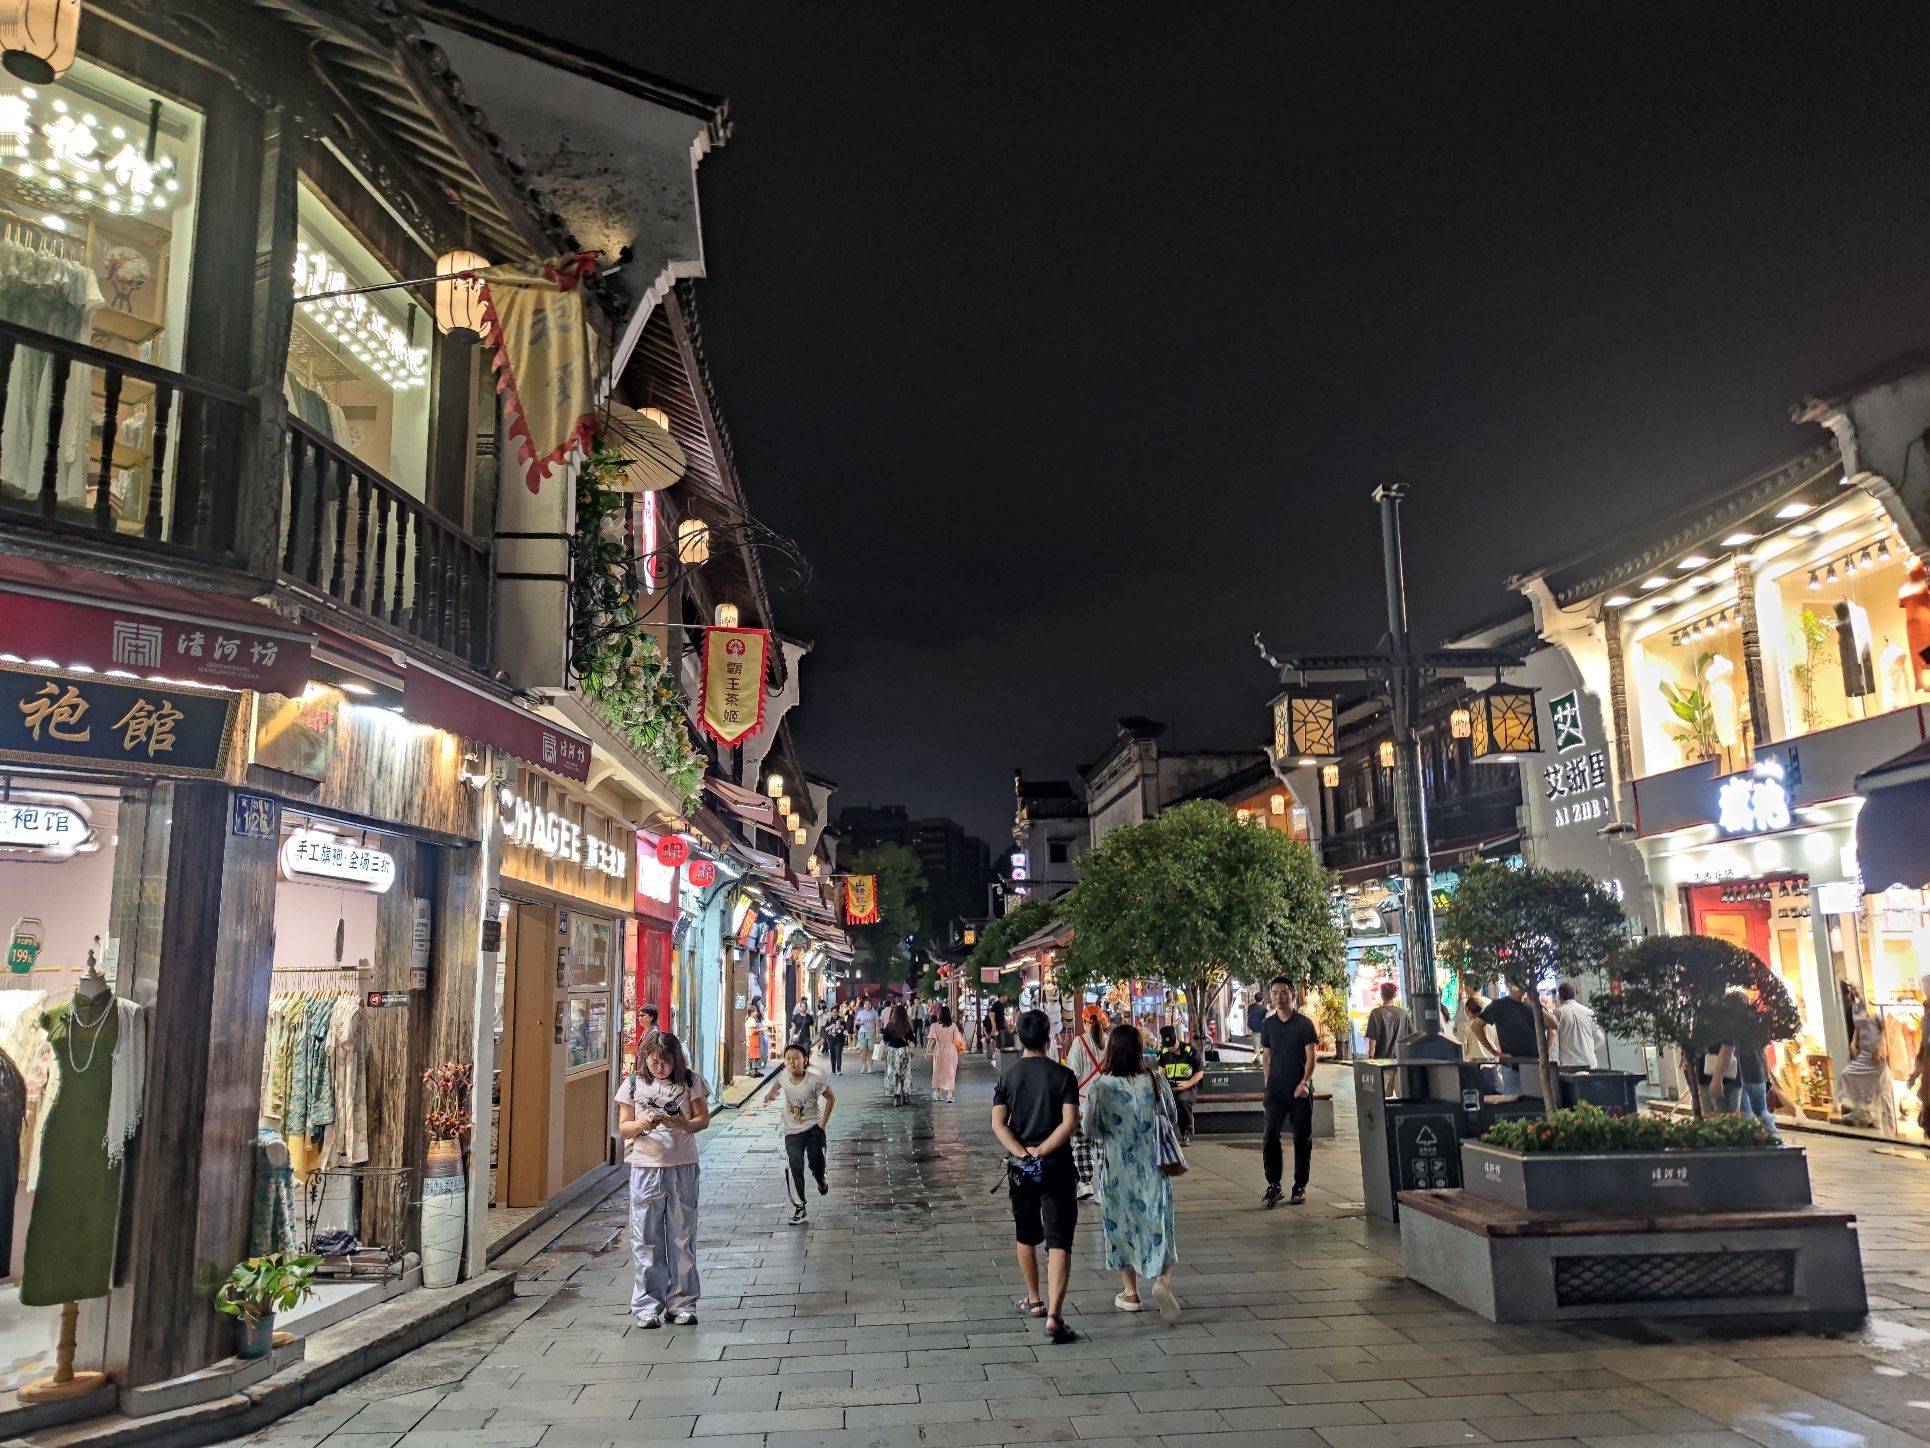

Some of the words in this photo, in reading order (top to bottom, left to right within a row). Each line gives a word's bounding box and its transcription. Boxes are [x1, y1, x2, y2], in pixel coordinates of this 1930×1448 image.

[177, 631, 278, 667] 清河坊
[198, 666, 237, 677] HANGZHOU
[238, 672, 260, 680] CHINA
[723, 661, 743, 723] 霸王茶姬
[19, 682, 184, 757] 袍館
[11, 808, 71, 832] 袍馆
[244, 811, 268, 833] 126
[501, 788, 581, 863] CHAGEE
[1555, 807, 1570, 828] AI
